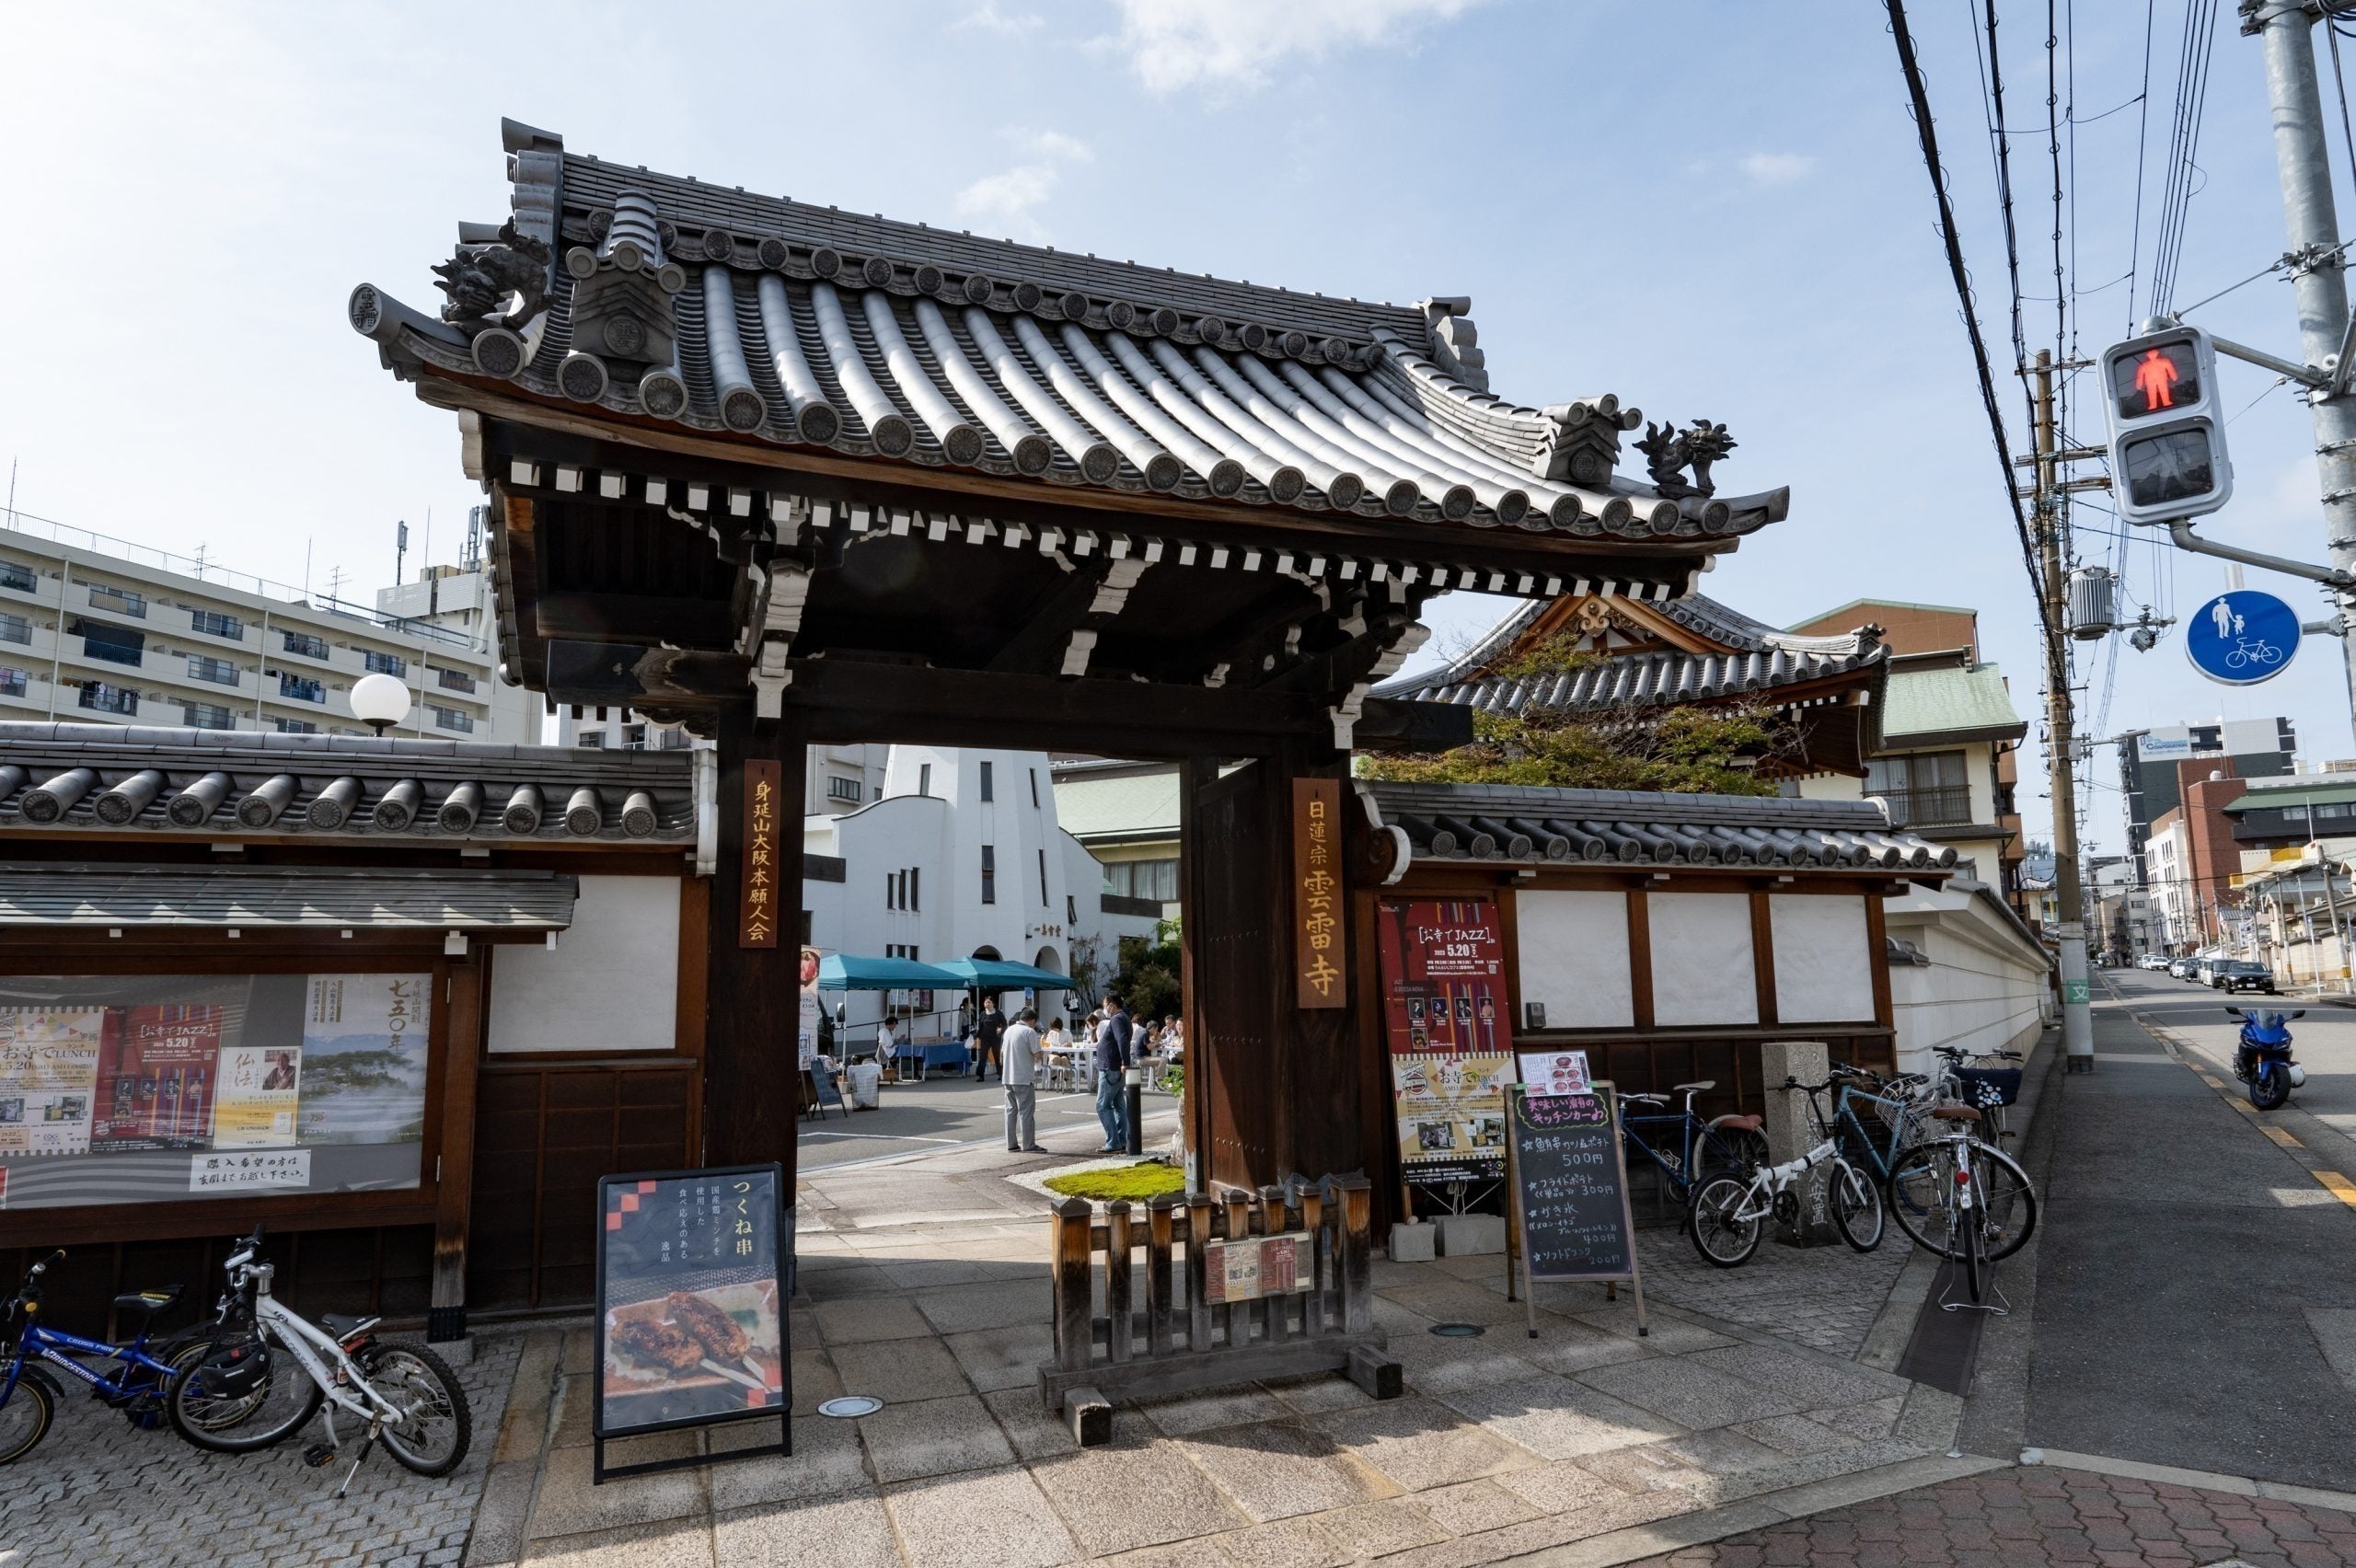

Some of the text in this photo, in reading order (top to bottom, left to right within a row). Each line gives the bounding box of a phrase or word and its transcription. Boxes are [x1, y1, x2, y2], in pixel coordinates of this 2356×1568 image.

[746, 780, 773, 940] 身延山大阪本願人会
[1447, 944, 1471, 957] 5.20
[166, 1038, 189, 1047] 5.20
[206, 1157, 297, 1170] 購入希望の方は
[1562, 1152, 1603, 1167] 500円
[1582, 1184, 1613, 1196] 300円
[697, 1186, 705, 1226] 使用した
[1541, 1202, 1579, 1218] かき氷
[679, 1188, 688, 1260] 食べ応えのある
[711, 1185, 721, 1256] 国産鶏ミンチを
[733, 1182, 753, 1256] つくね串
[1583, 1234, 1616, 1245] 400円
[661, 1240, 670, 1262] 逸品
[1589, 1254, 1620, 1265] 200円
[66, 1337, 115, 1353] CROSS FIRE
[42, 1347, 99, 1384] BRIDGESTONE
